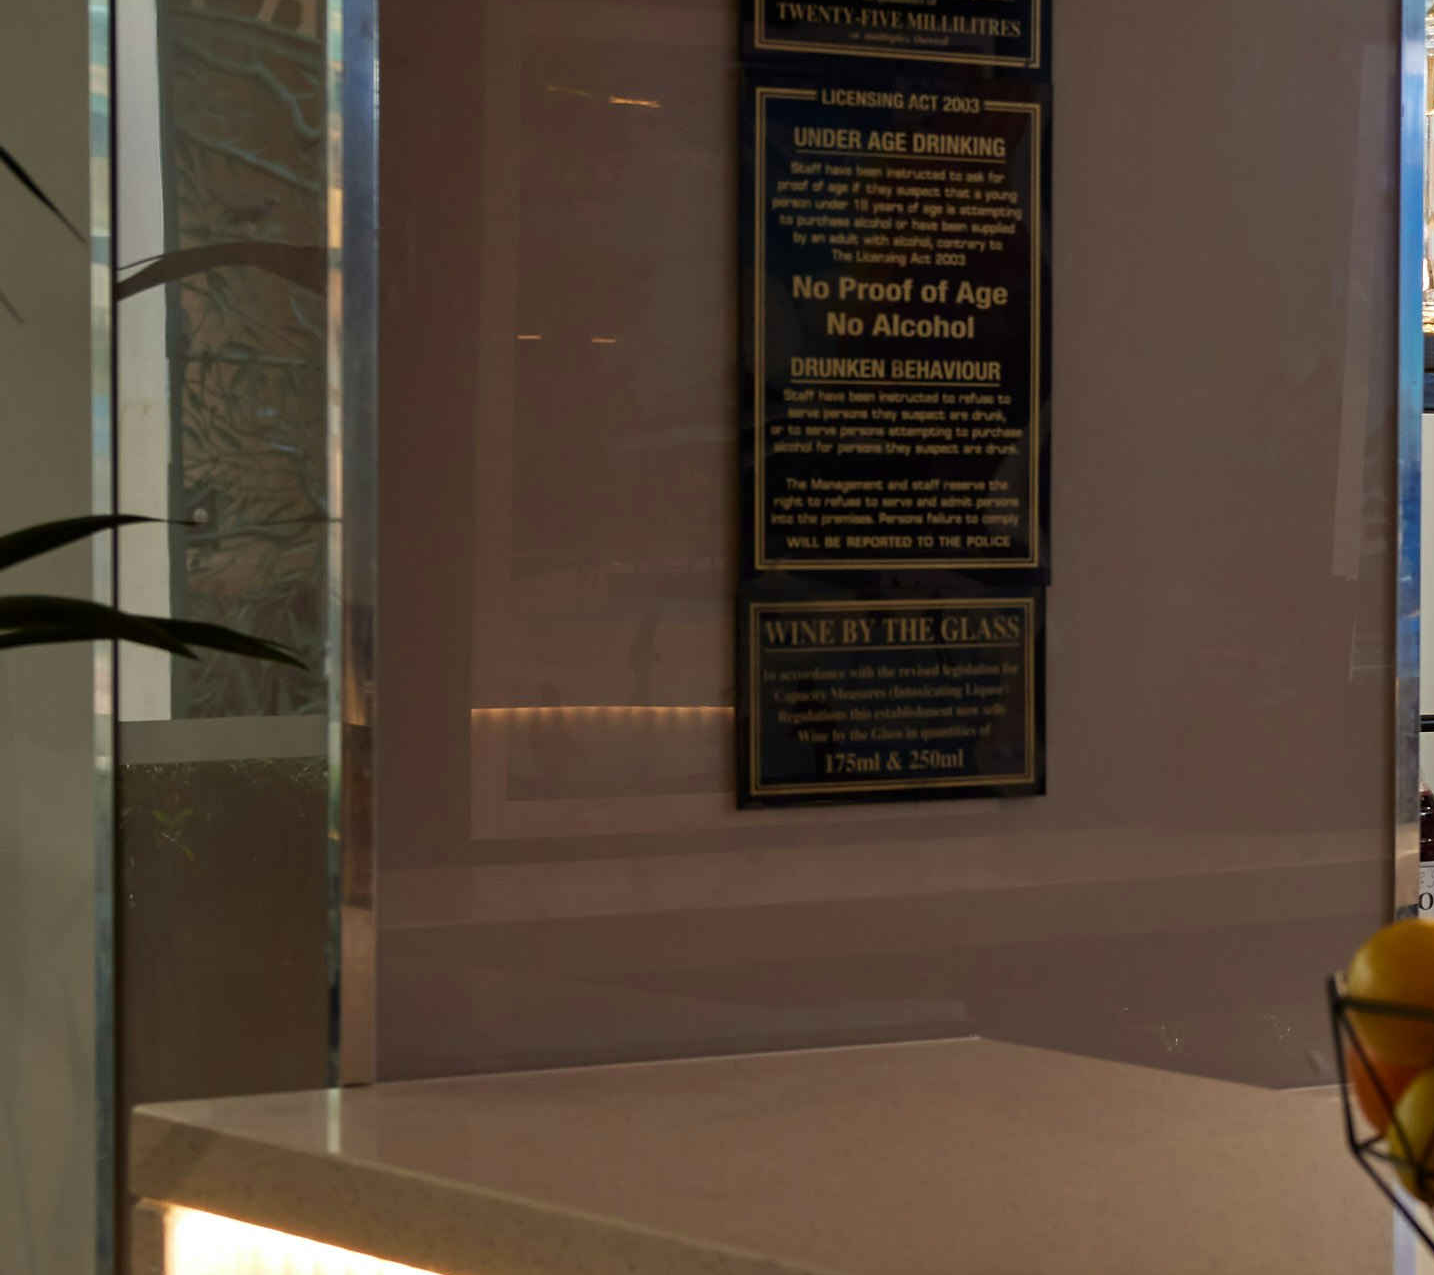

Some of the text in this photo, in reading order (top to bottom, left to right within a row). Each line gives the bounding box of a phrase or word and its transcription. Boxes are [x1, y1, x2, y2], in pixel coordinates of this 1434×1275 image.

[776, 2, 1022, 38] TWENTY-FIVE MILLILITRES
[822, 88, 980, 114] LICENSING ACT 2003
[794, 127, 1006, 158] UNDER AGE DRINKING
[793, 275, 1008, 310] No Proof of Age
[827, 312, 975, 339] No Alcohol
[790, 357, 1001, 381] DRUNKEN BEHAVIOUR
[765, 616, 1021, 646] WINE BY THE GLASS
[825, 749, 964, 774] 175ml & 250ml
